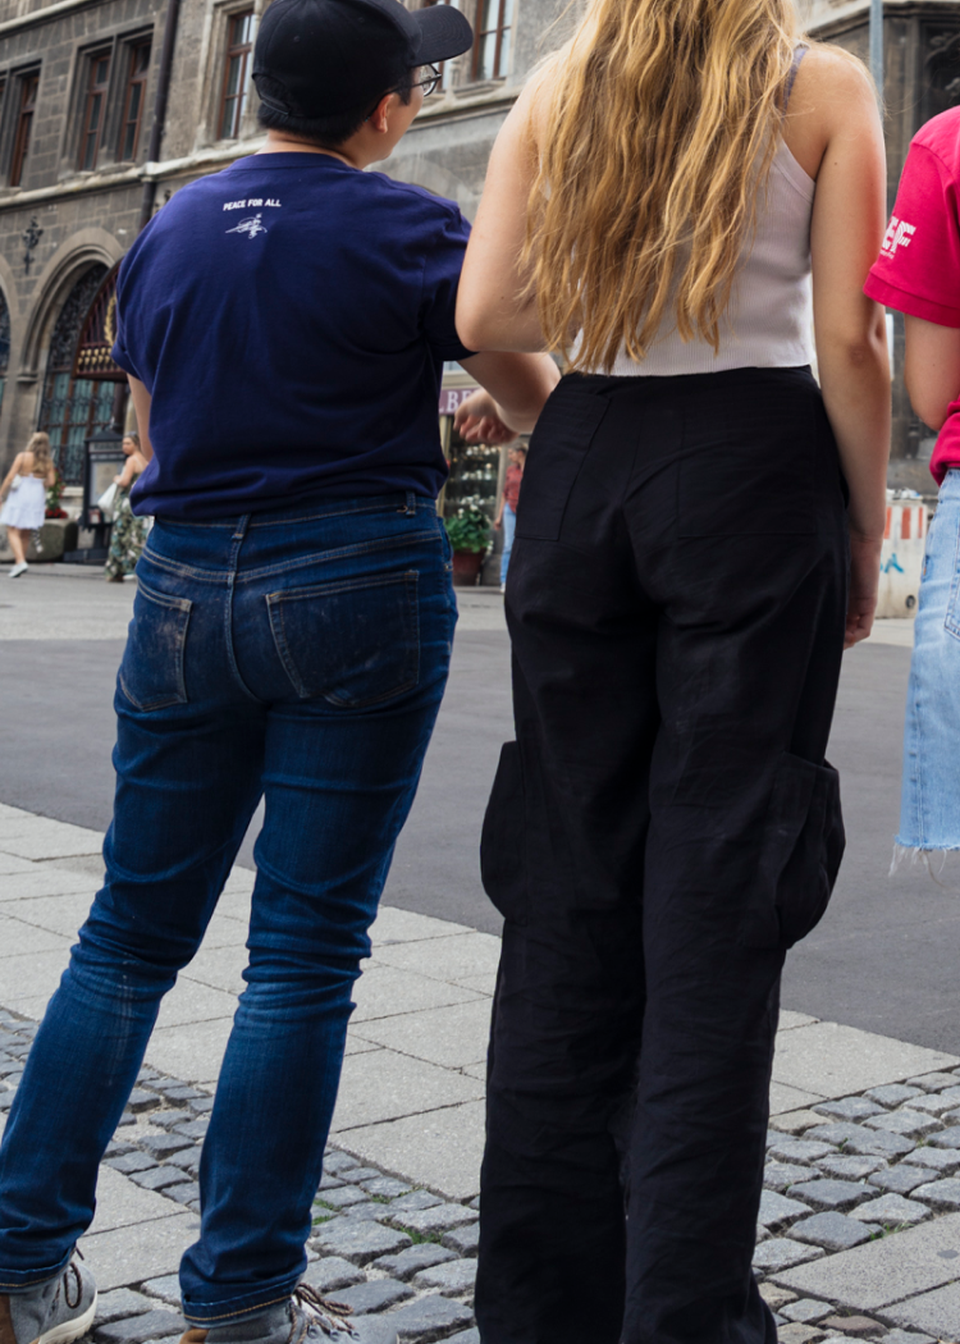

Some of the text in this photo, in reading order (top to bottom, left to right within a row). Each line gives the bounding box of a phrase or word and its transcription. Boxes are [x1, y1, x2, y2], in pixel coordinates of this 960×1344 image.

[223, 199, 281, 211] PEACE FOR ALL
